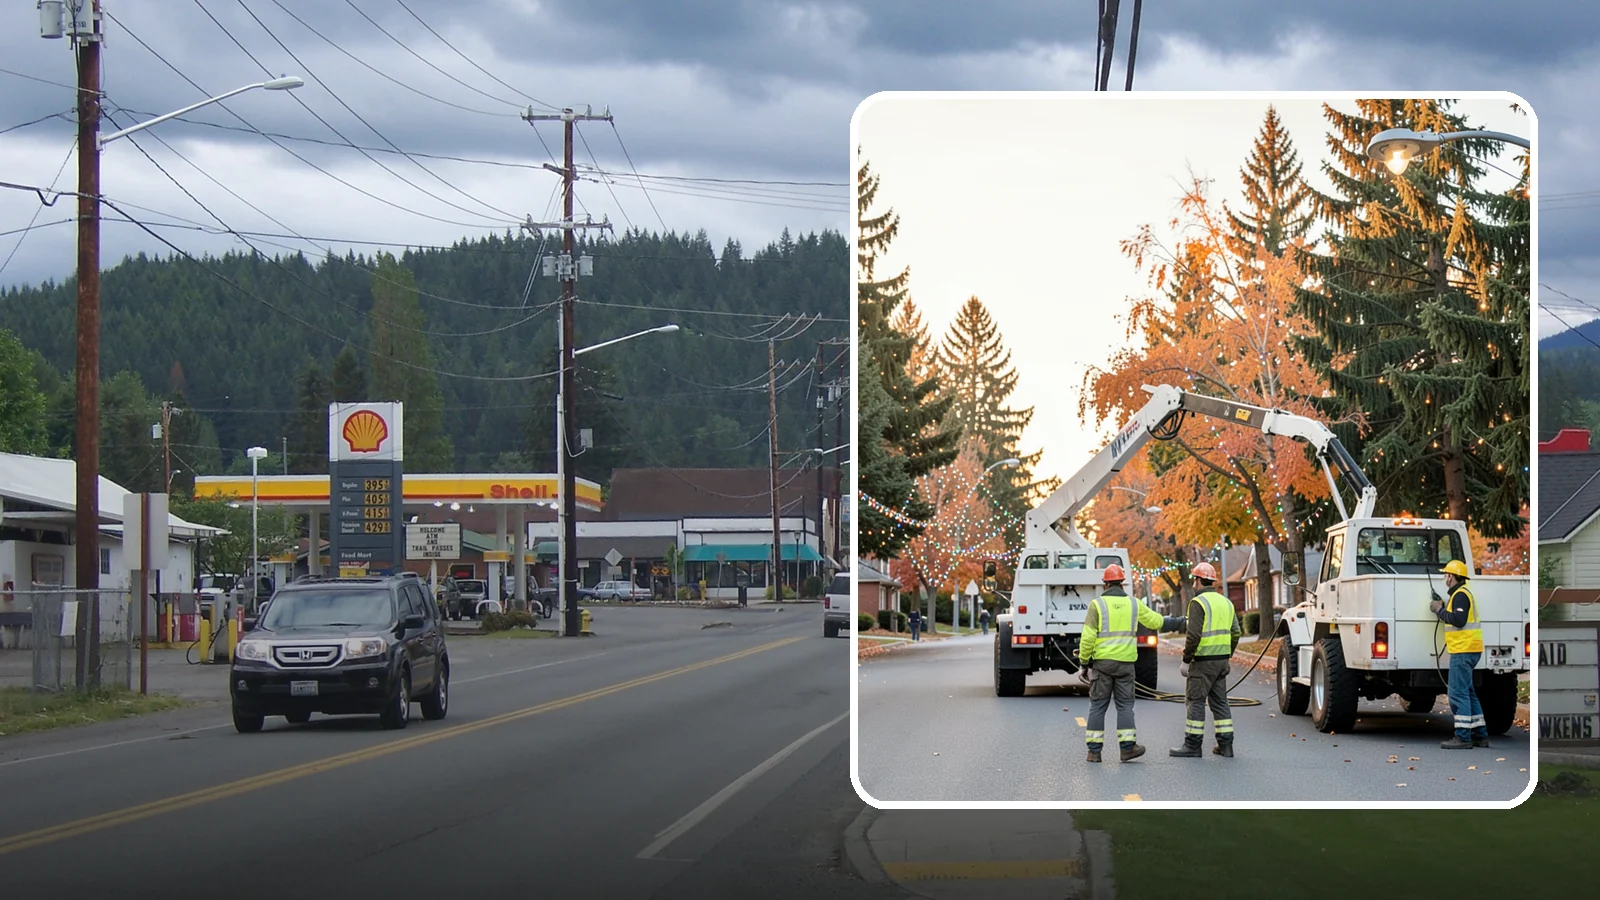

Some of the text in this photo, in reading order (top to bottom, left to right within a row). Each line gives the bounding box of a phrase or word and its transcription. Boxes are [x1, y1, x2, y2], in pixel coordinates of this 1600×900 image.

[365, 480, 383, 490] 395
[490, 484, 547, 499] Shell
[365, 494, 383, 504] 405
[365, 508, 383, 518] 415
[365, 522, 383, 532] 429
